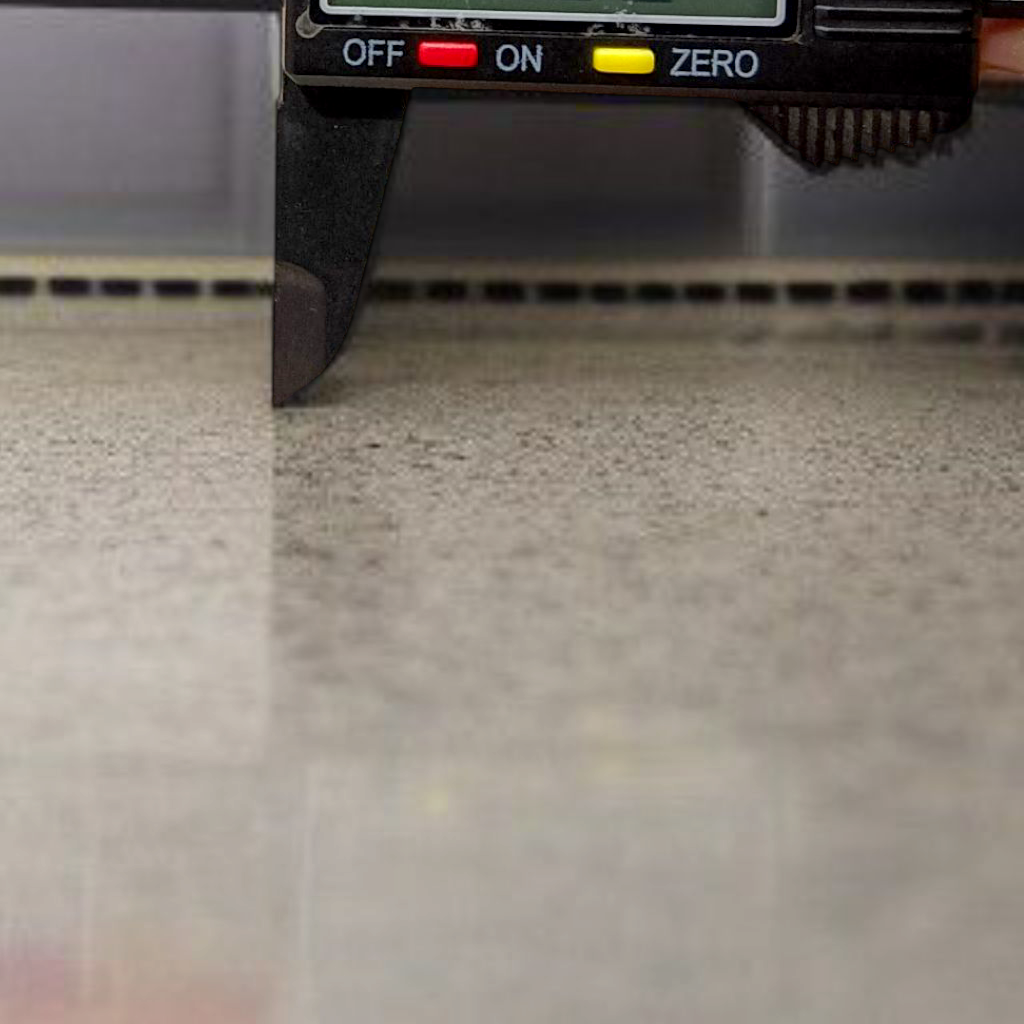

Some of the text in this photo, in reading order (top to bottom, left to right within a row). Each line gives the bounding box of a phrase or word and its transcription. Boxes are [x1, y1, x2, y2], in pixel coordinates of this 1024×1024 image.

[343, 39, 404, 67] OFF
[496, 45, 543, 72] ON
[670, 49, 759, 77] ZERO
